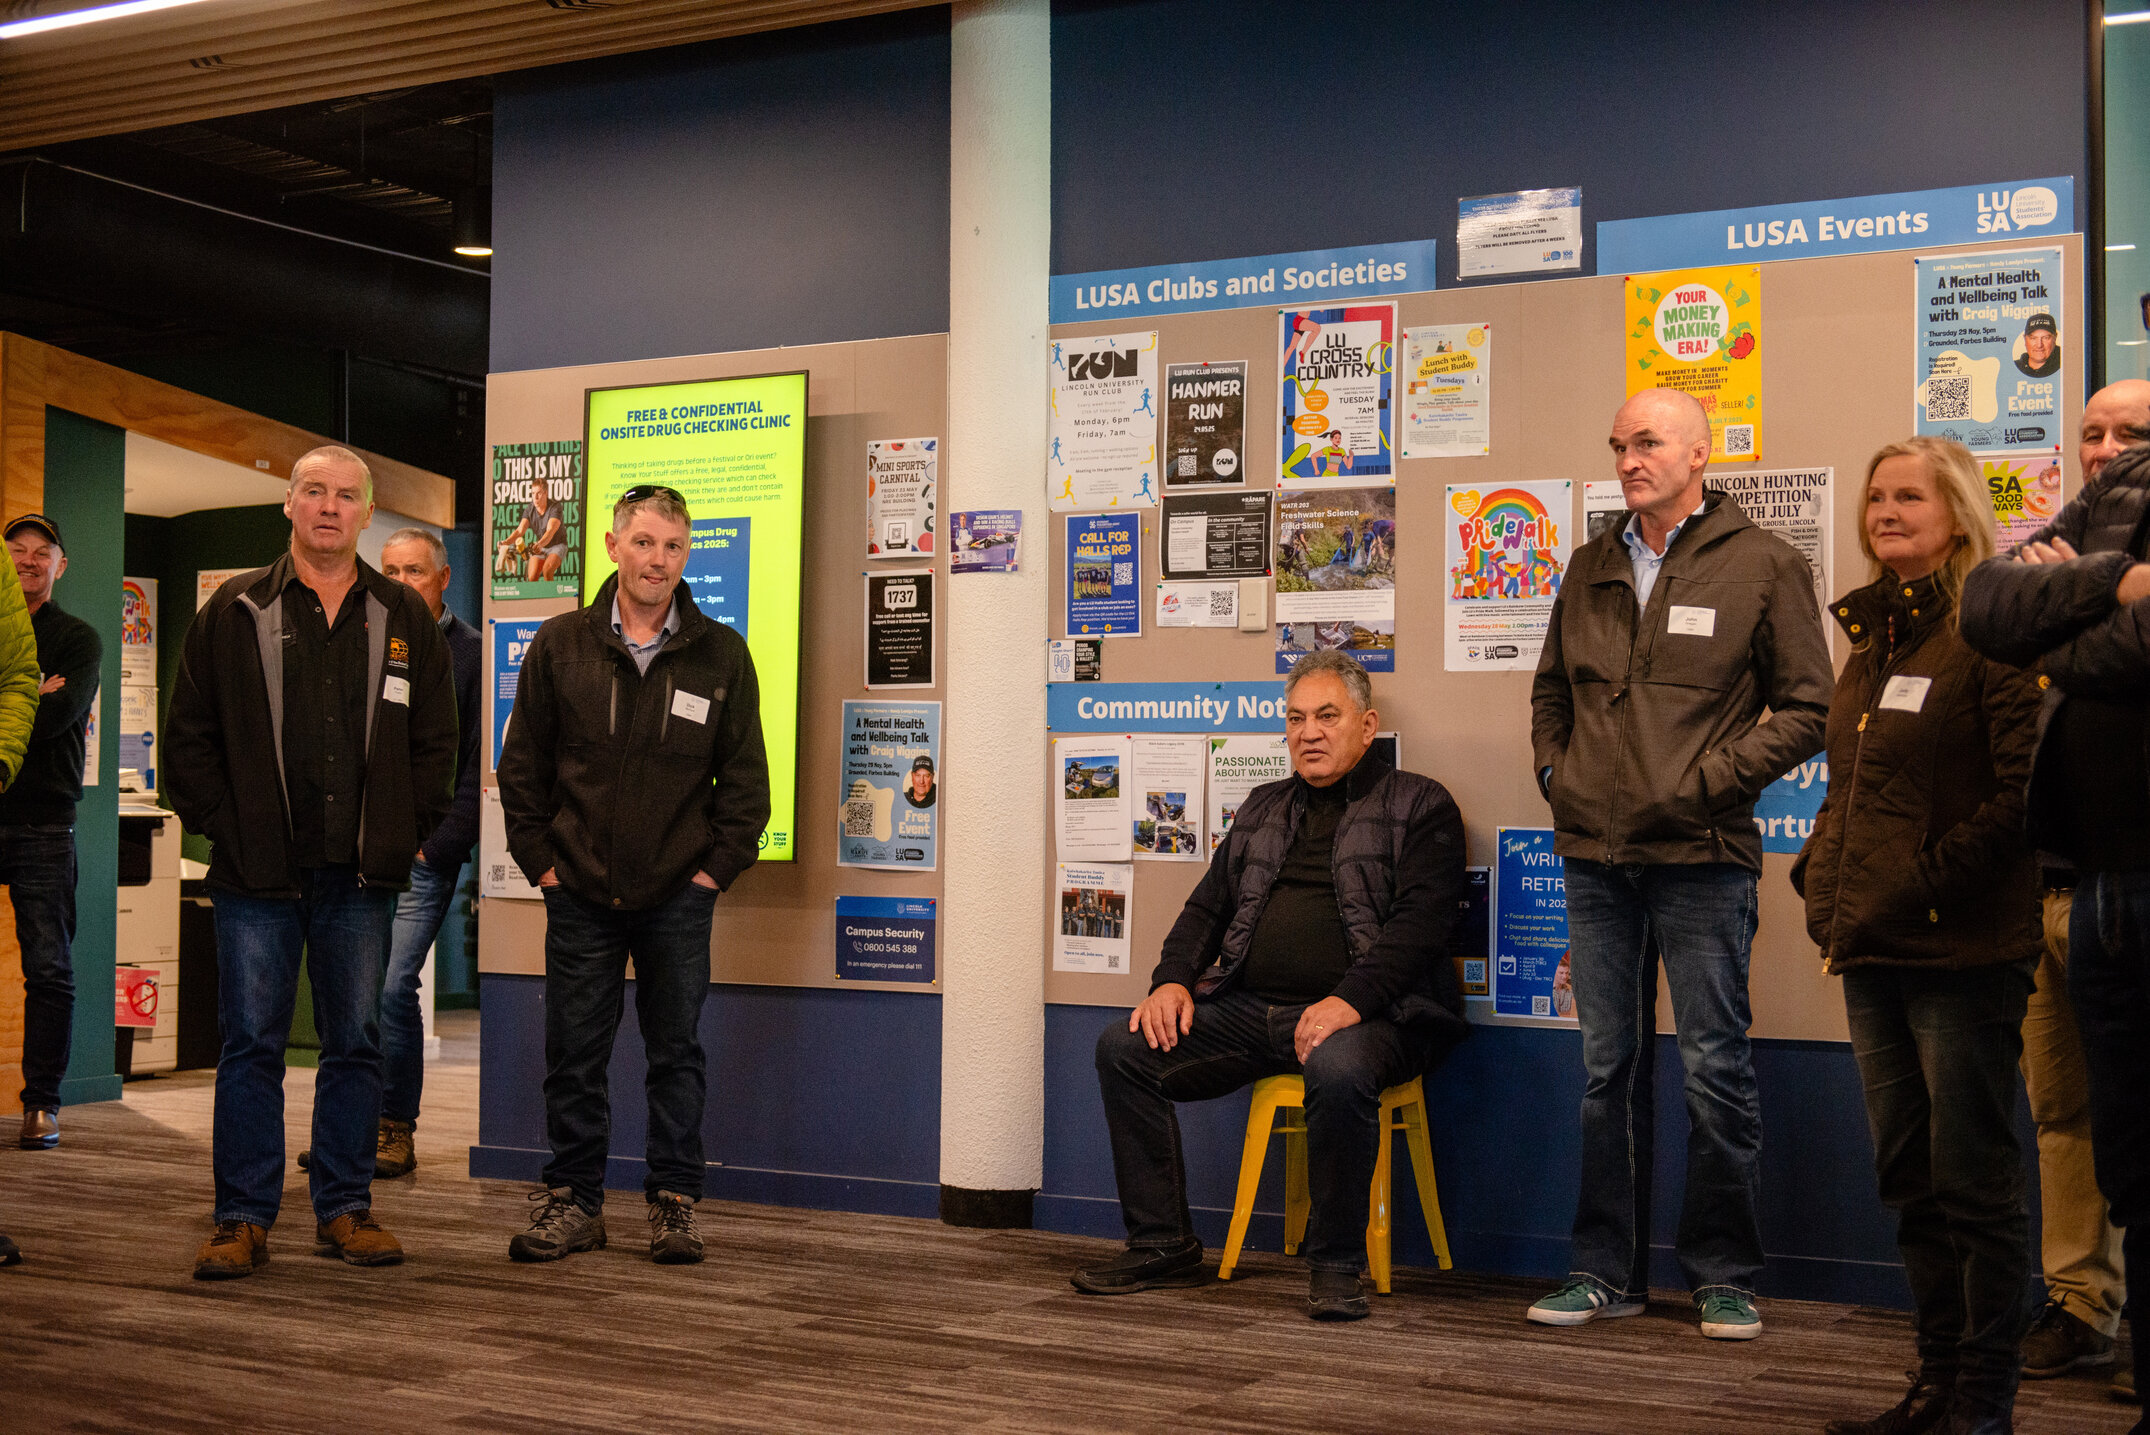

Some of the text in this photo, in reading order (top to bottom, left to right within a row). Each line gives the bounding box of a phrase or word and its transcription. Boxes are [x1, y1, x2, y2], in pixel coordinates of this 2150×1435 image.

[1978, 191, 2009, 213] LU
[1977, 212, 2011, 234] SA
[1728, 211, 1929, 250] LUSA Events
[1076, 259, 1406, 309] LUSA Clubs and Societies
[1938, 269, 2040, 289] A Mental Health
[1675, 290, 1707, 304] YOUR
[1931, 285, 2048, 306] and Wellbeing Talk
[1663, 305, 1720, 325] MONEY
[1929, 303, 2050, 322] with Craig Wiggins
[1662, 322, 1720, 342] MAKING
[1983, 327, 1996, 335] 5pm
[1326, 333, 1346, 348] LU
[1678, 339, 1708, 354] ERA!
[1310, 347, 1362, 365] CROSS
[1426, 354, 1468, 367] Lunch with
[1298, 362, 1375, 381] COUNTRY
[1420, 361, 1475, 376] Student Buddy
[1061, 379, 1145, 391] LINCOLN UNIVERSITY
[1172, 380, 1240, 400] HANMER
[2017, 380, 2053, 396] Free
[1339, 396, 1374, 404] TUESDAY
[1721, 400, 1744, 408] SELLER!
[2008, 395, 2053, 411] Event
[627, 401, 763, 423] FREE & CONFIDENTIAL
[1188, 403, 1223, 420] RUN
[1358, 407, 1374, 415] 7AM
[600, 414, 791, 440] ONSITE DRUG CHECKING CLINIC
[1074, 418, 1109, 426] Monday,
[504, 455, 572, 480] THIS IS MY
[876, 461, 926, 472] MINI SPORTS
[674, 477, 702, 486] checking
[880, 473, 920, 484] CARNIVAL
[1703, 473, 1826, 491] LINCOLN HUNTING
[494, 478, 573, 504] SPACE TOO
[1732, 489, 1812, 505] MPETITION
[1991, 494, 2023, 502] FOOD
[1770, 505, 1802, 518] JULY
[1993, 503, 2023, 511] WAYS
[1281, 509, 1359, 520] Freshwater Science
[716, 528, 737, 537] Drug
[1302, 522, 1324, 530] Skills
[704, 539, 729, 548] 2025:
[1079, 531, 1129, 543] CALL FOR
[1077, 544, 1131, 557] HALLS REP
[704, 575, 721, 584] 3pm
[707, 595, 724, 604] 3pm
[888, 590, 914, 603] 1737
[1078, 695, 1230, 725] Community
[863, 718, 925, 730] Mental Health
[851, 732, 929, 745] and Wellbeing Talk
[849, 744, 930, 759] with Craig Wiggins
[1215, 757, 1286, 766] PASSIONATE
[1214, 768, 1287, 777] ABOUT WASTE?
[905, 810, 930, 822] Free
[899, 822, 930, 835] Event
[1503, 838, 1529, 857] Join
[1535, 899, 1567, 908] IN 202
[845, 926, 924, 940] Campus Security
[864, 943, 917, 953] 0800 545 388
